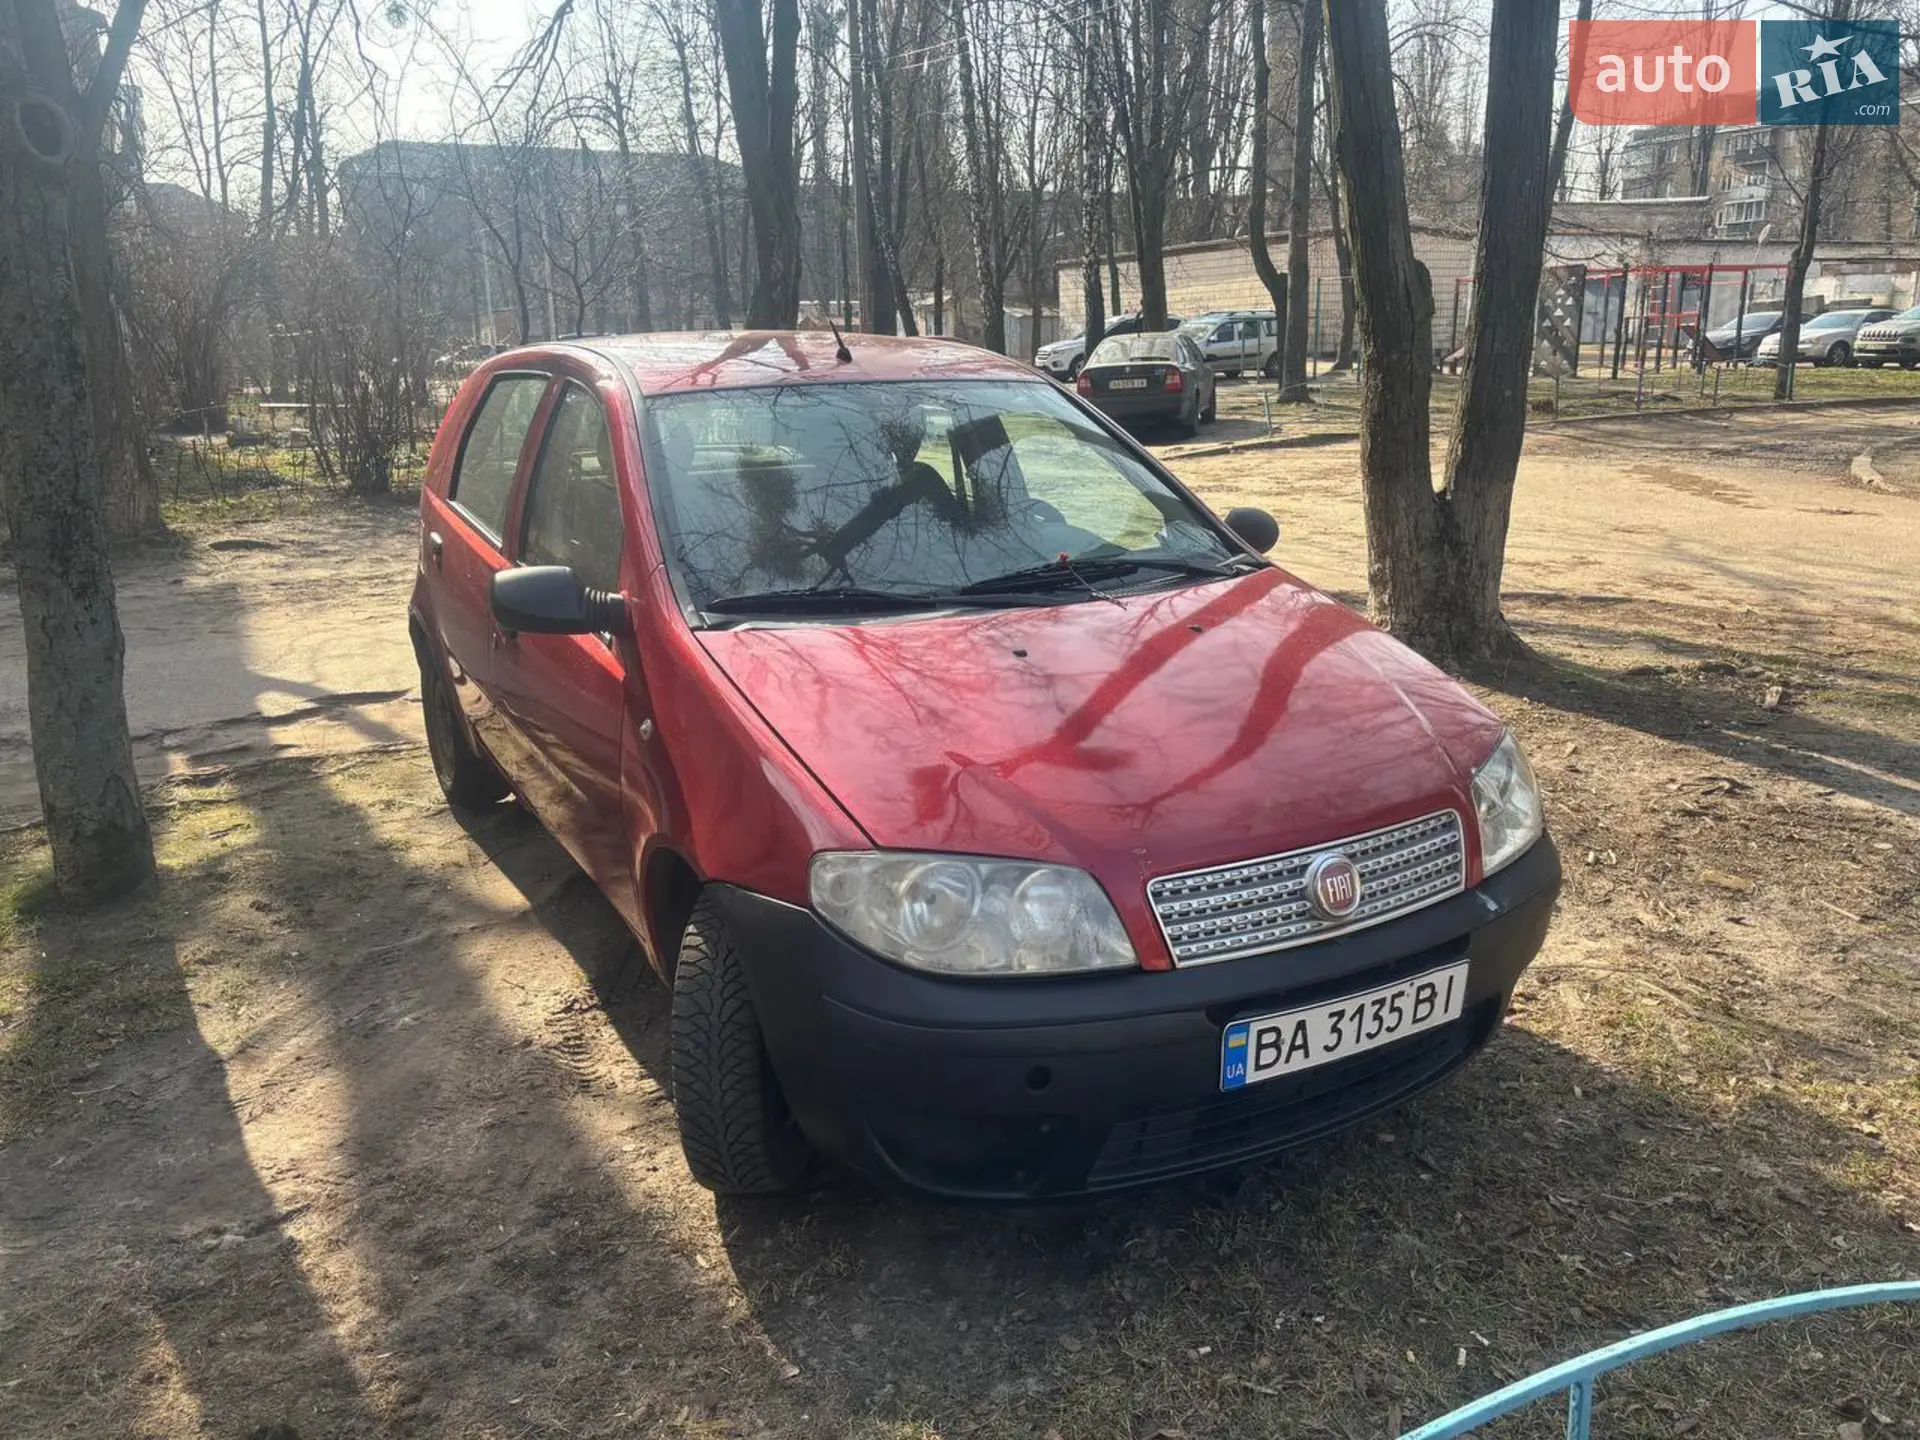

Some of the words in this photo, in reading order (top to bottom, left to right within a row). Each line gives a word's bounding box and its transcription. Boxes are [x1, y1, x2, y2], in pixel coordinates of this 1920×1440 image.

[1326, 872, 1352, 903] FIAT
[1254, 1019, 1310, 1072] BA
[1323, 991, 1405, 1053] 3135
[1226, 1062, 1245, 1079] UA
